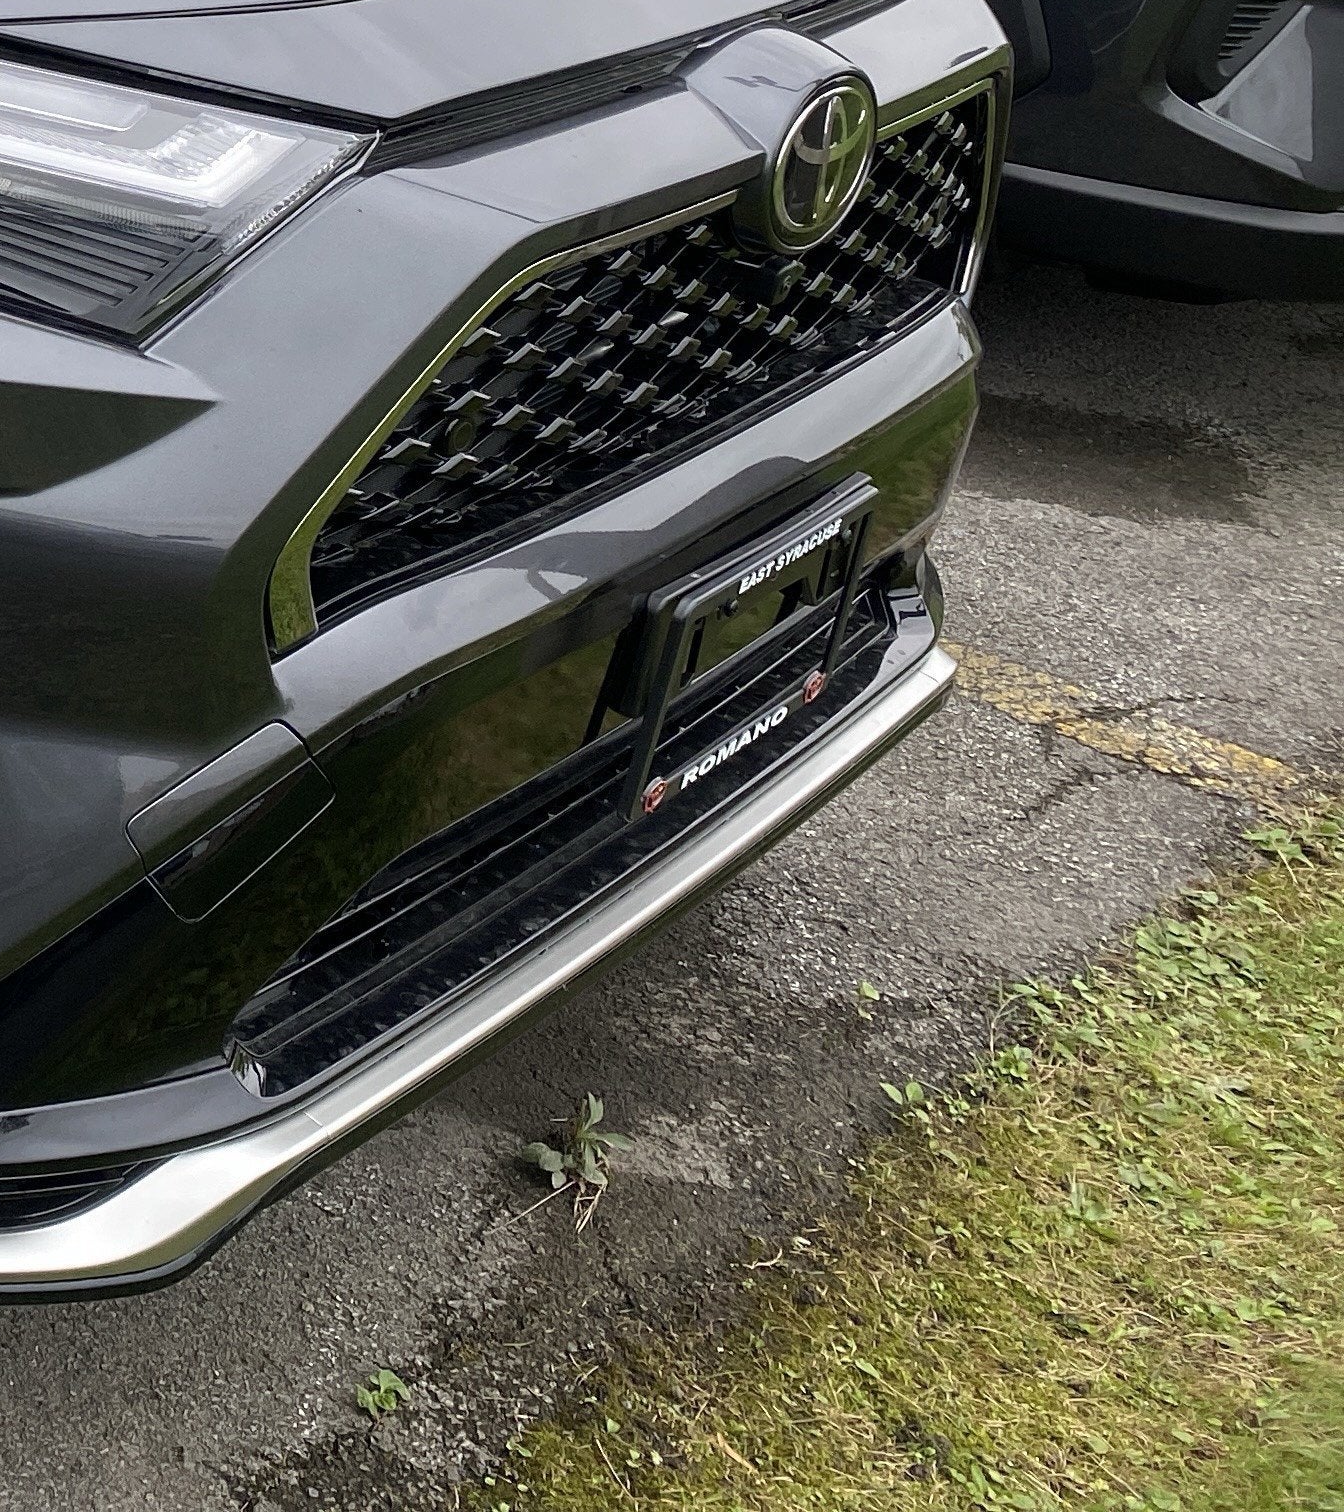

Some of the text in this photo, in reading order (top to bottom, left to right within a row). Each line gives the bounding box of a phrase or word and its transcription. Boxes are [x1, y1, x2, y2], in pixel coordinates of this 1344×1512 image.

[738, 518, 843, 595] EAST SYRACUSE
[680, 705, 789, 791] ROMANO
